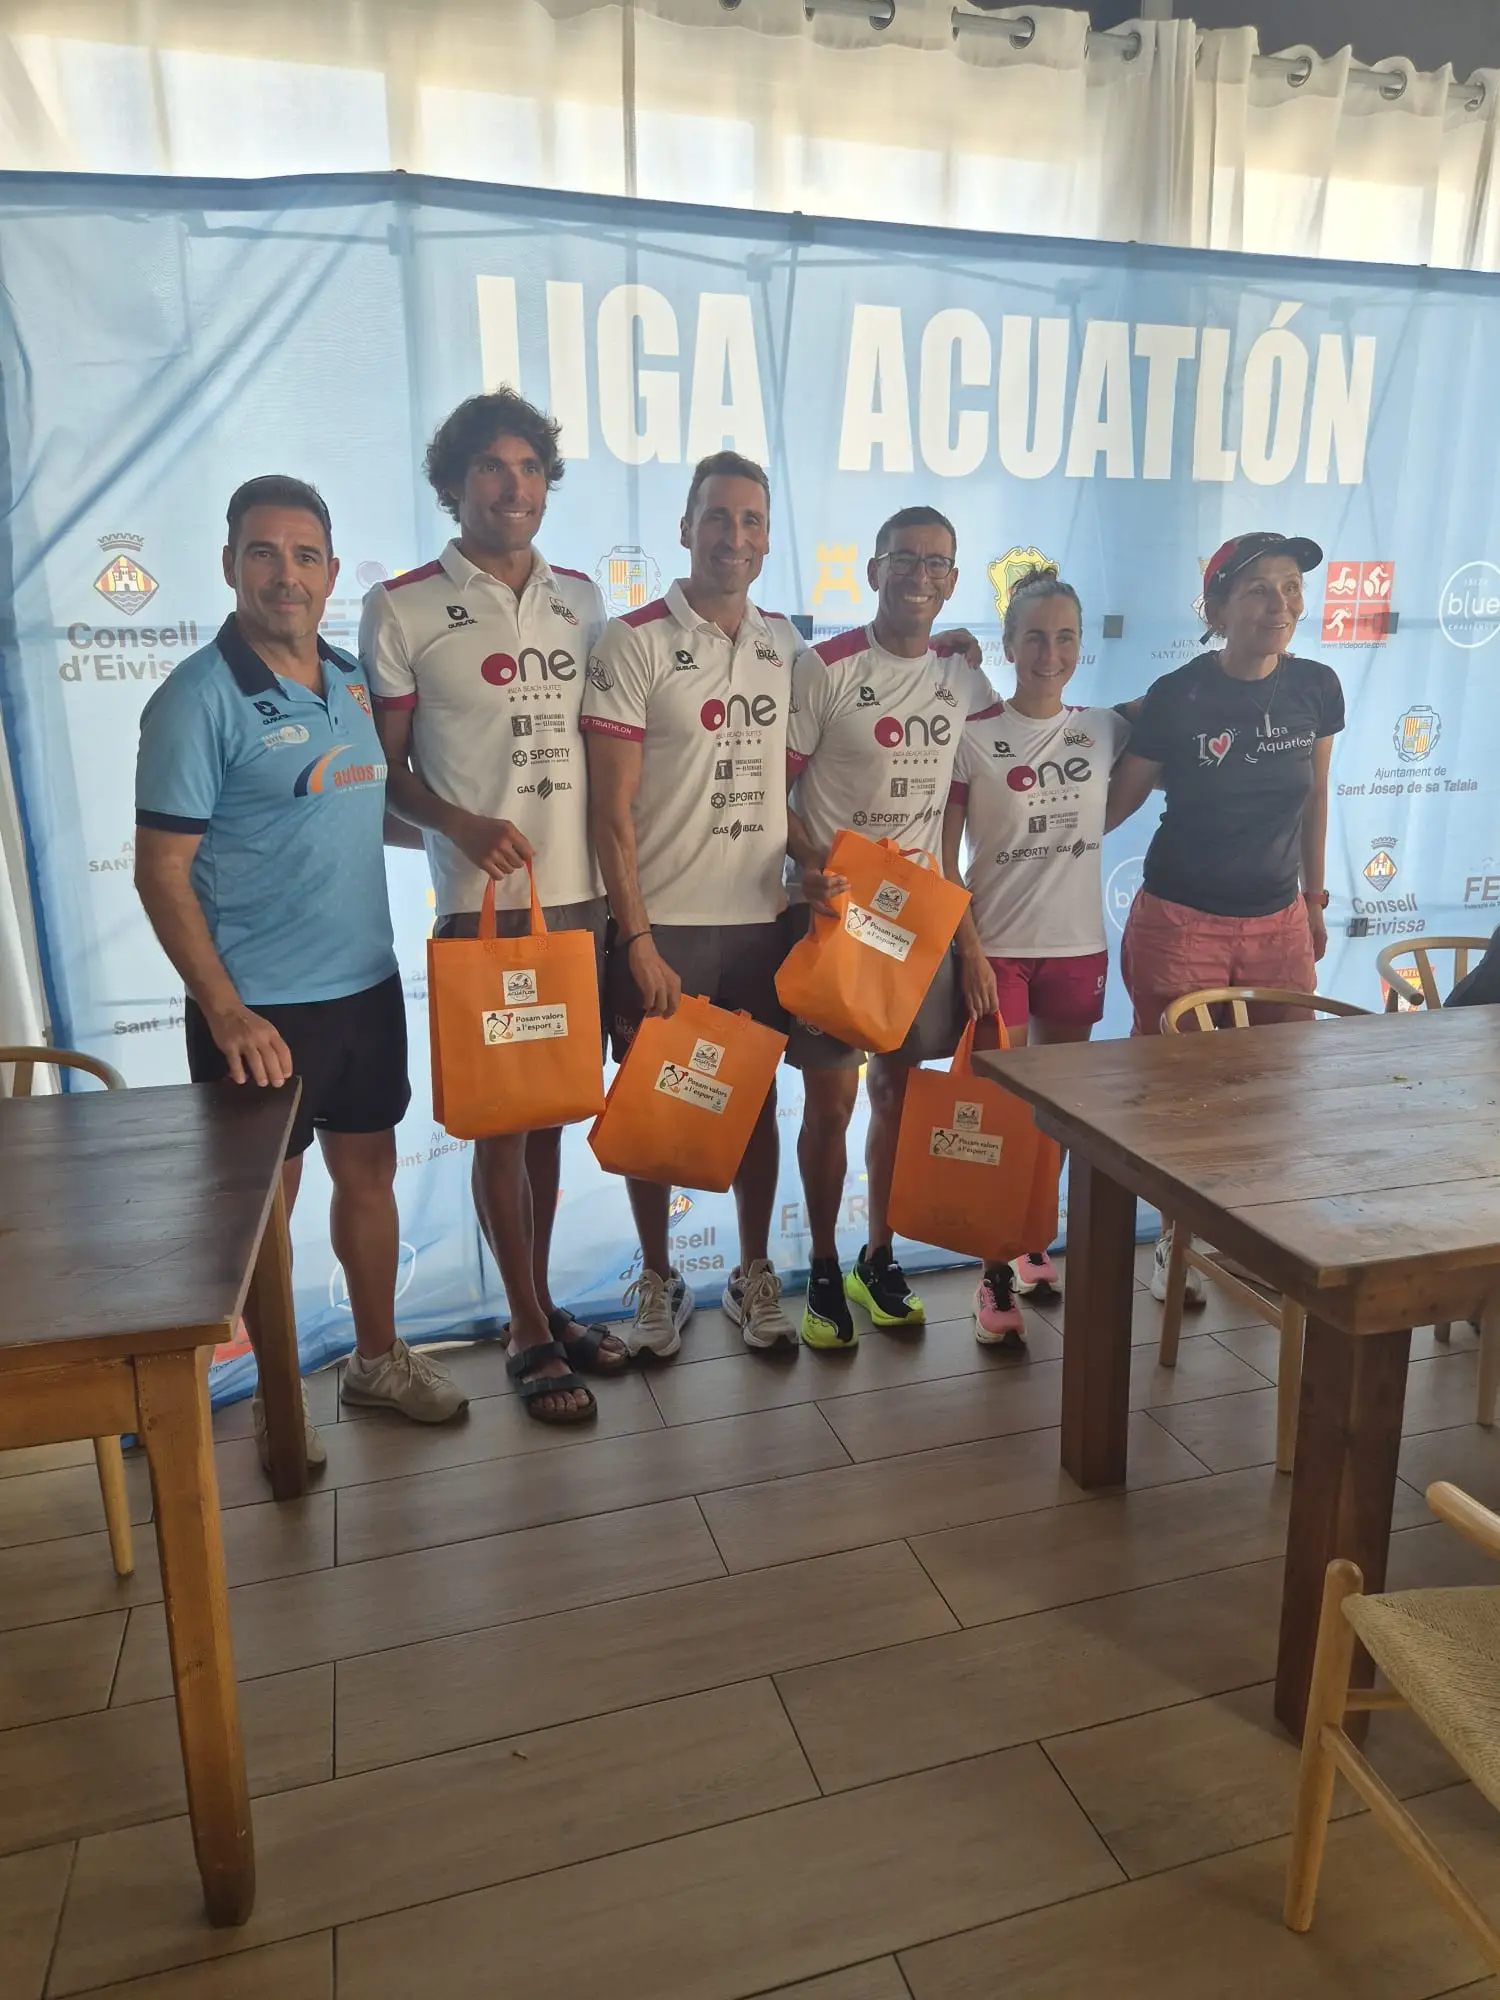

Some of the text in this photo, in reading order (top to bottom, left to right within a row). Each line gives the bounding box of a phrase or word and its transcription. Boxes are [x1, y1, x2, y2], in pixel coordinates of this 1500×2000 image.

[476, 274, 1377, 485] LIGA ACUATLÓN
[1447, 591, 1500, 619] blue
[67, 620, 198, 650] Consell
[58, 653, 175, 682] d'Eivis
[592, 719, 632, 735] TRIATHLON
[1256, 726, 1289, 738] Lga
[530, 747, 570, 760] SPORTY
[334, 763, 388, 788] autosm
[1374, 766, 1447, 781] Ajuntament de
[517, 782, 572, 794] GAS IBIZA
[728, 790, 766, 803] SPORTY
[1336, 779, 1478, 797] Sant Josep de sa Talaia
[869, 813, 911, 823] SPORTY
[712, 824, 764, 835] GAS IBIZA
[1011, 846, 1050, 859] SPORTY
[1056, 844, 1072, 853] GAS
[1352, 893, 1419, 915] Consell
[870, 921, 910, 946] Posam valors
[1346, 917, 1426, 938] d'Eivissa
[515, 1012, 565, 1023] Posam valors
[113, 1018, 160, 1036] Sant
[522, 1022, 552, 1032] l'esport
[687, 1077, 728, 1098] Posam valors
[396, 1140, 468, 1168] ant Josep
